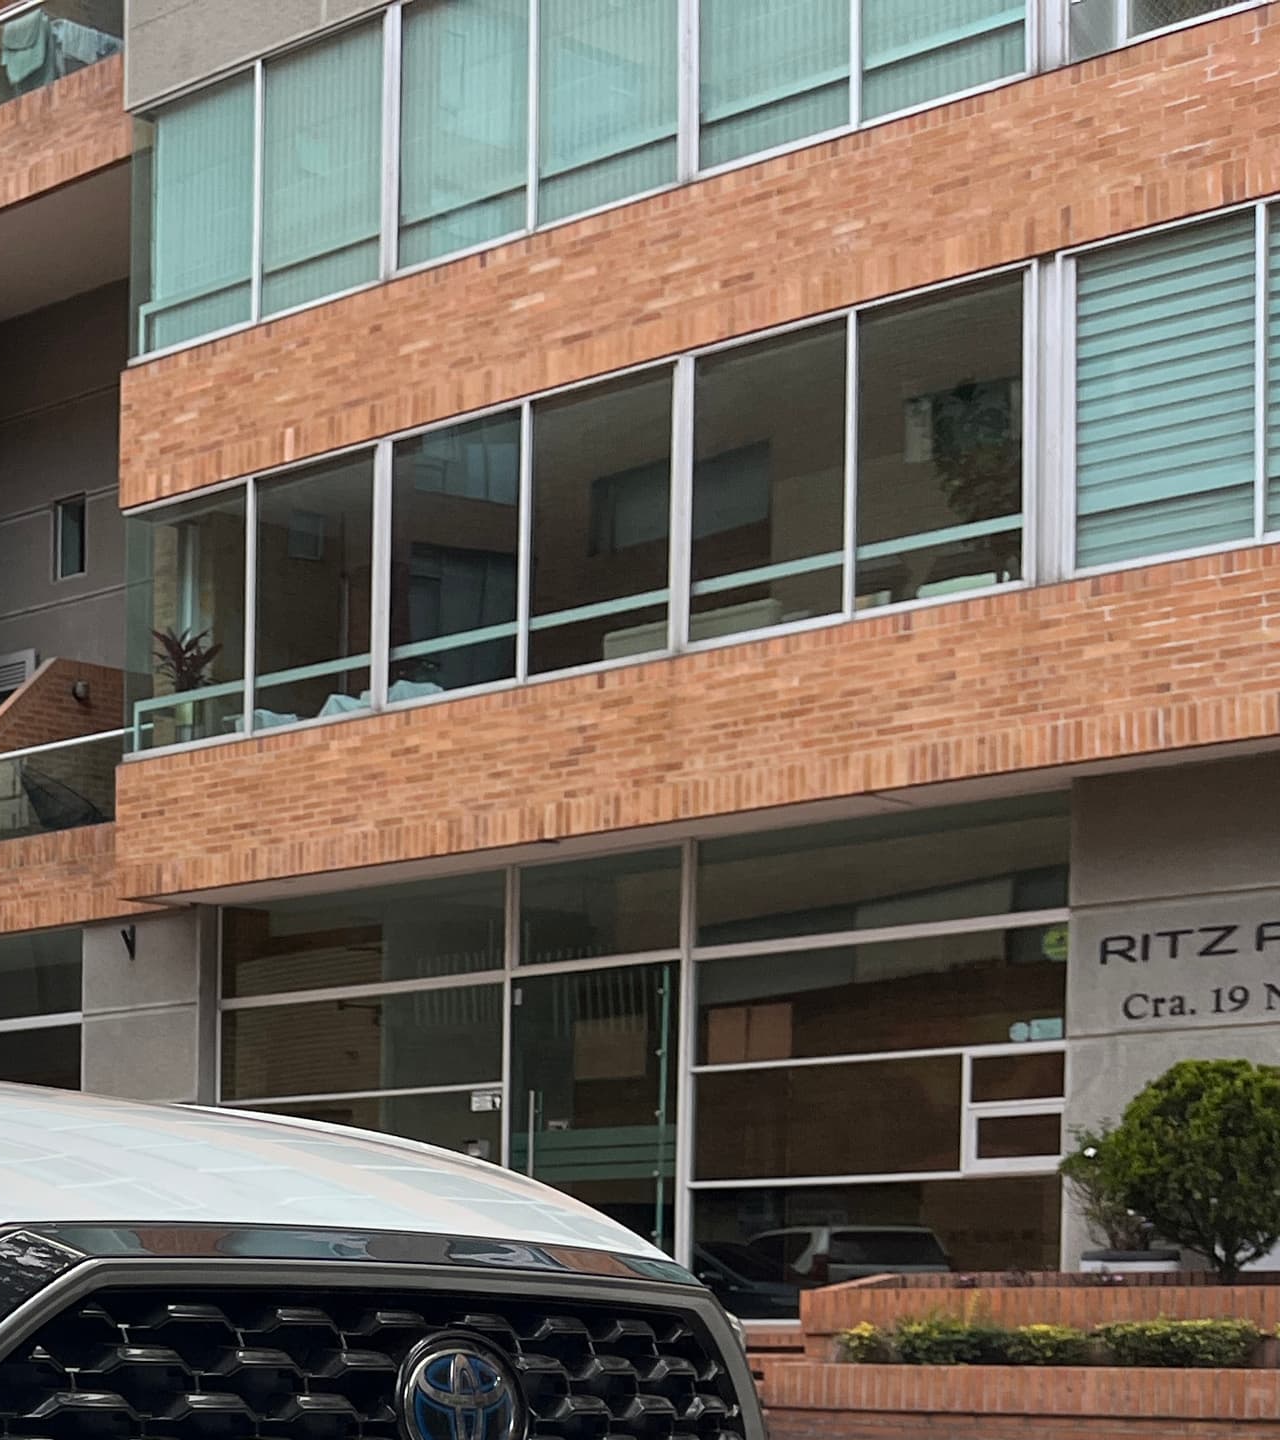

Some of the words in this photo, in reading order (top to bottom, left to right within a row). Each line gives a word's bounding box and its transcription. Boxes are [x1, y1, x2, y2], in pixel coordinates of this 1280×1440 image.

[1099, 924, 1238, 965] RITZ
[1122, 993, 1196, 1020] Cra.
[1211, 985, 1249, 1013] 19
